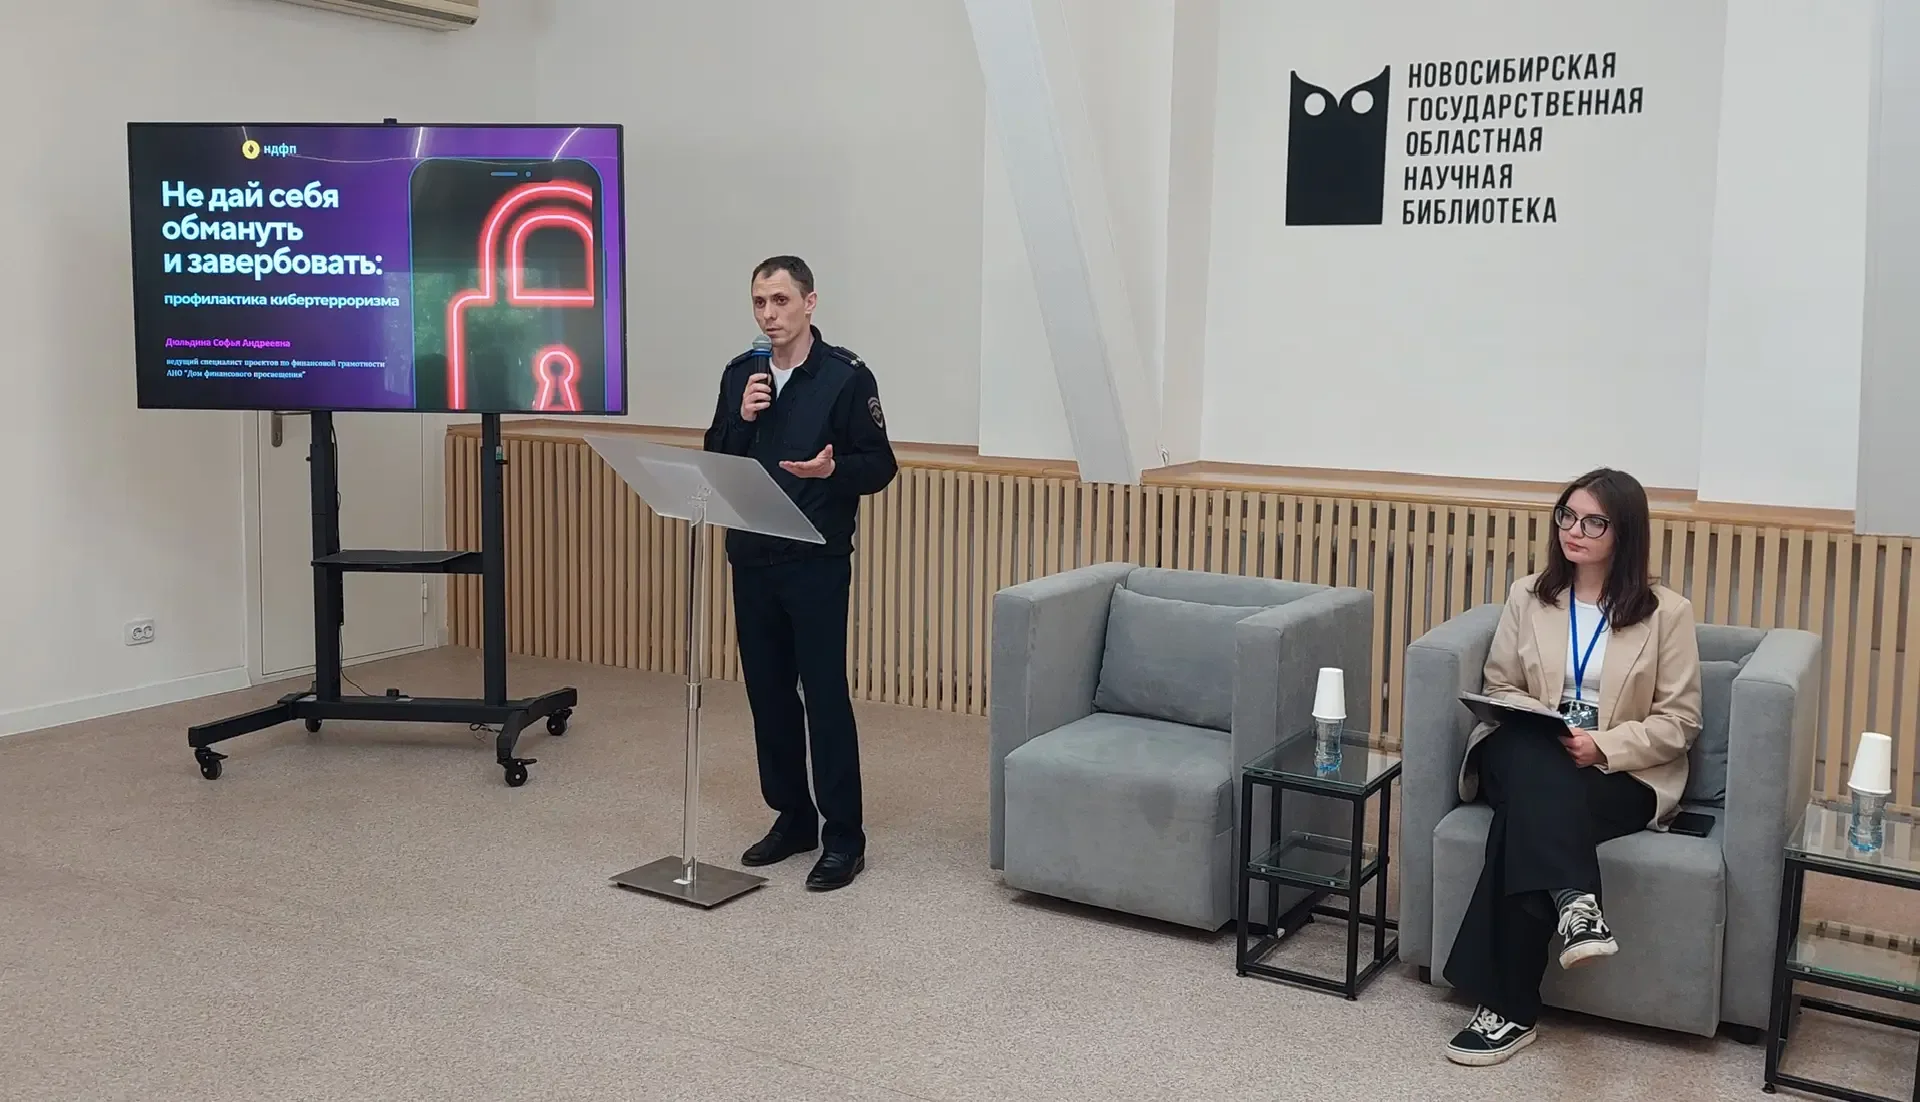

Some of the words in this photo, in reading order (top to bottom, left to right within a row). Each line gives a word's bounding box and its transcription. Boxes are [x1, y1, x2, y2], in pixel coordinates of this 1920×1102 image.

[1408, 52, 1617, 88] НОВОСИБИРСКАЯ
[1407, 87, 1644, 123] ГОСУДАРСТВЕННАЯ
[1406, 127, 1543, 156] ОБЛАСТНАЯ
[1404, 164, 1513, 190] НАУЧНАЯ
[162, 181, 205, 207] Не
[208, 181, 263, 212] дай
[269, 180, 339, 208] себя
[1403, 197, 1557, 224] БИБЛИОТЕКА
[162, 213, 304, 248] обмануть
[164, 253, 182, 273] и
[187, 247, 383, 281] завербовать:
[164, 293, 267, 307] профилактика
[270, 293, 400, 308] кибертерроризма
[165, 338, 211, 348] Дюльдина
[213, 338, 241, 348] Софья
[242, 339, 291, 348] Андреевна
[166, 358, 199, 367] ведущий
[200, 359, 243, 367] специалист
[244, 360, 278, 368] проектов
[291, 359, 336, 369] финансовой
[338, 361, 385, 369] грамотности
[204, 370, 252, 379] финансового
